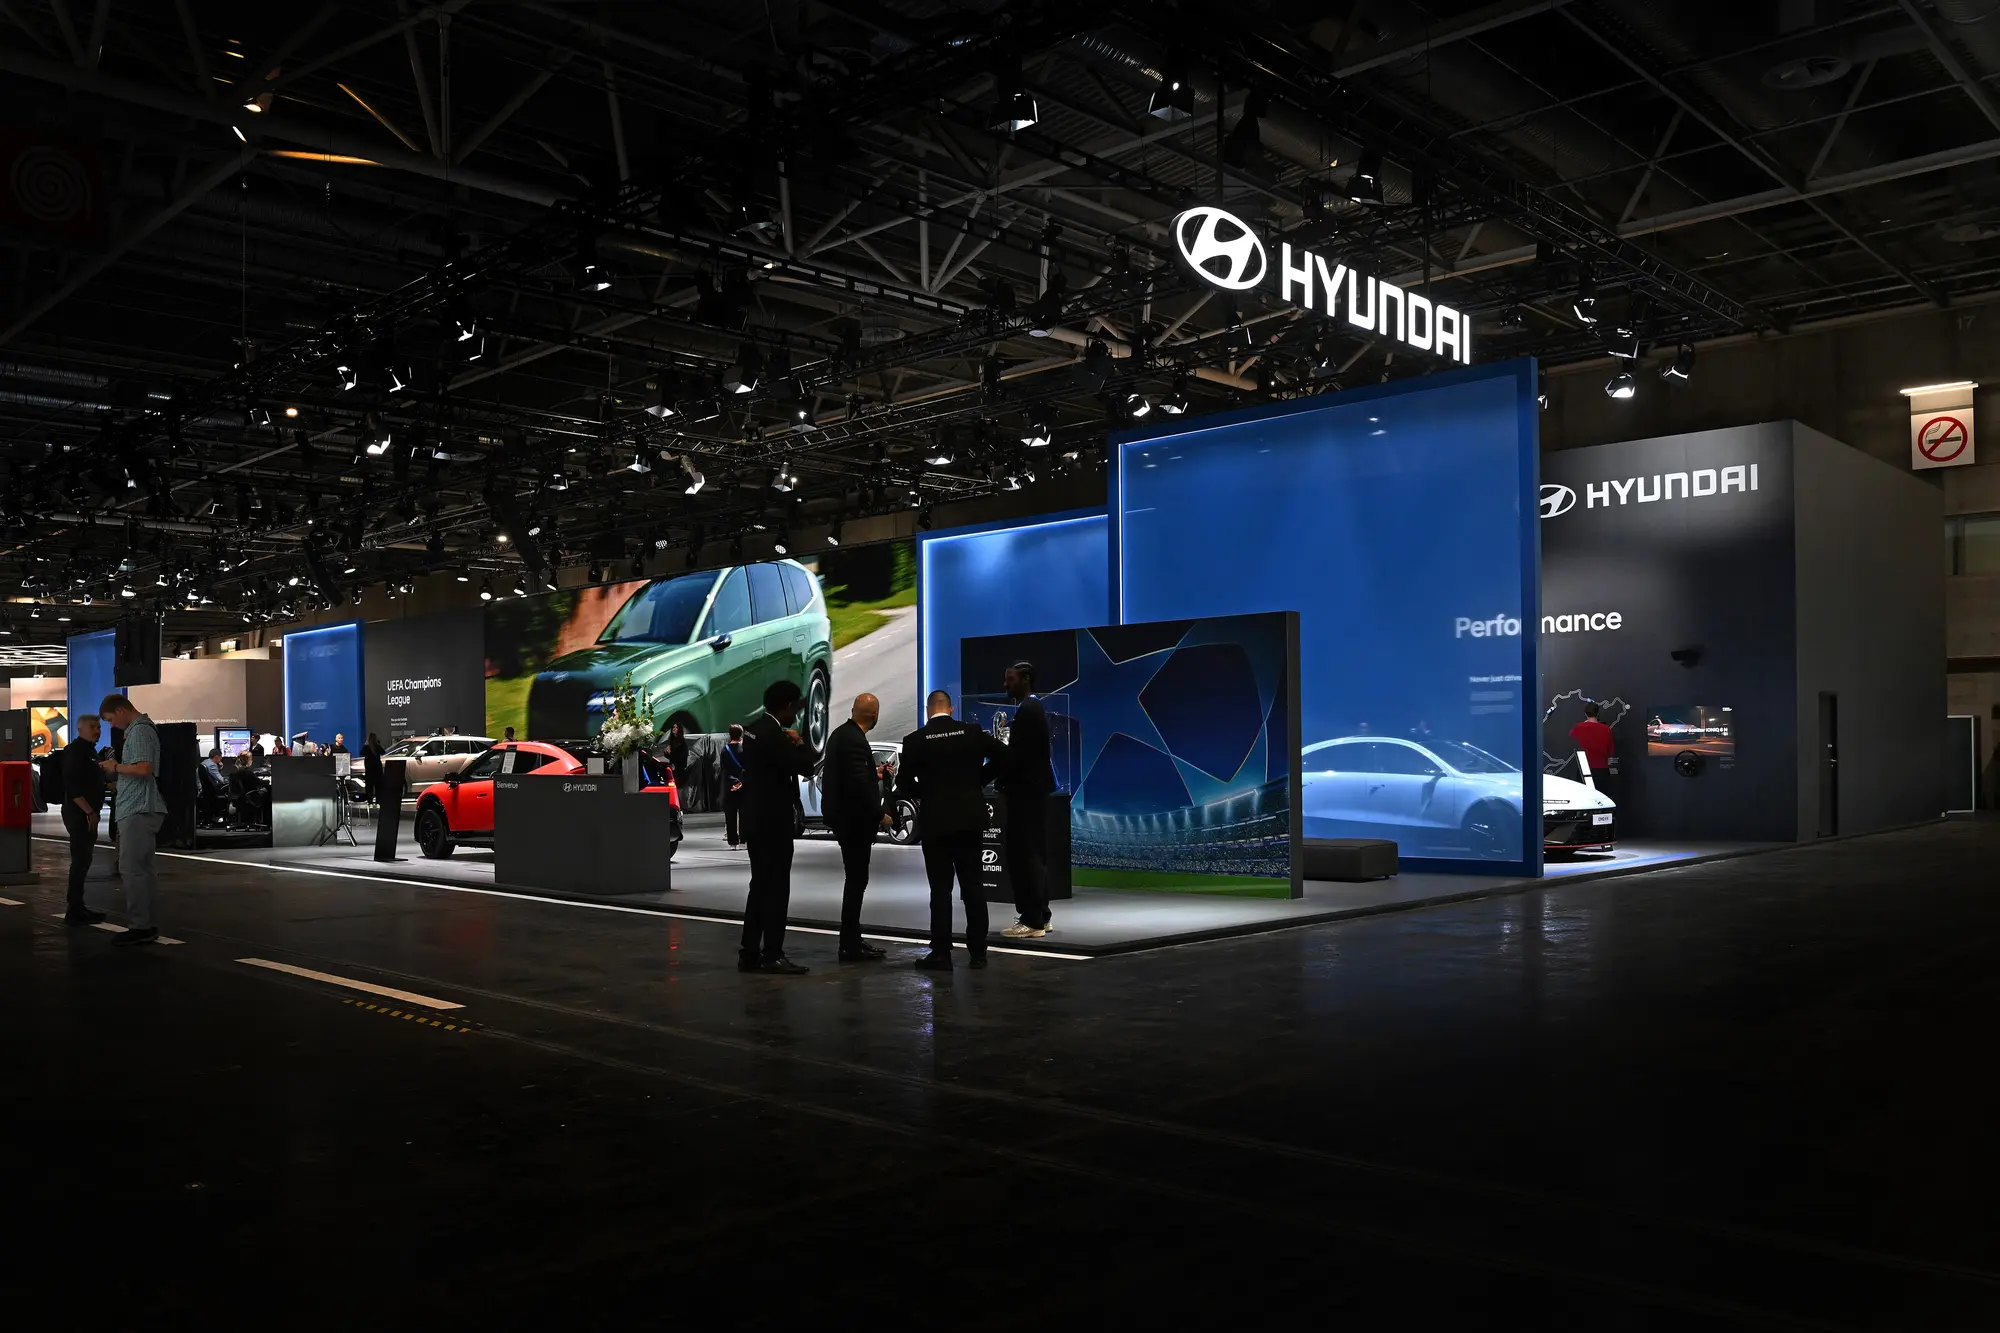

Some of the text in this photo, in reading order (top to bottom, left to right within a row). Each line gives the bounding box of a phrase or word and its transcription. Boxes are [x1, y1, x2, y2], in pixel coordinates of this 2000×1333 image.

[1282, 241, 1470, 366] HYUNDAI
[1956, 315, 1976, 331] 17
[1586, 463, 1759, 509] HYUNDAI
[387, 676, 442, 692] UEFA Champions
[387, 694, 411, 708] League
[496, 780, 519, 789] Bienvenue
[572, 783, 598, 792] HYUNDAI
[982, 864, 1002, 873] UNDAI
